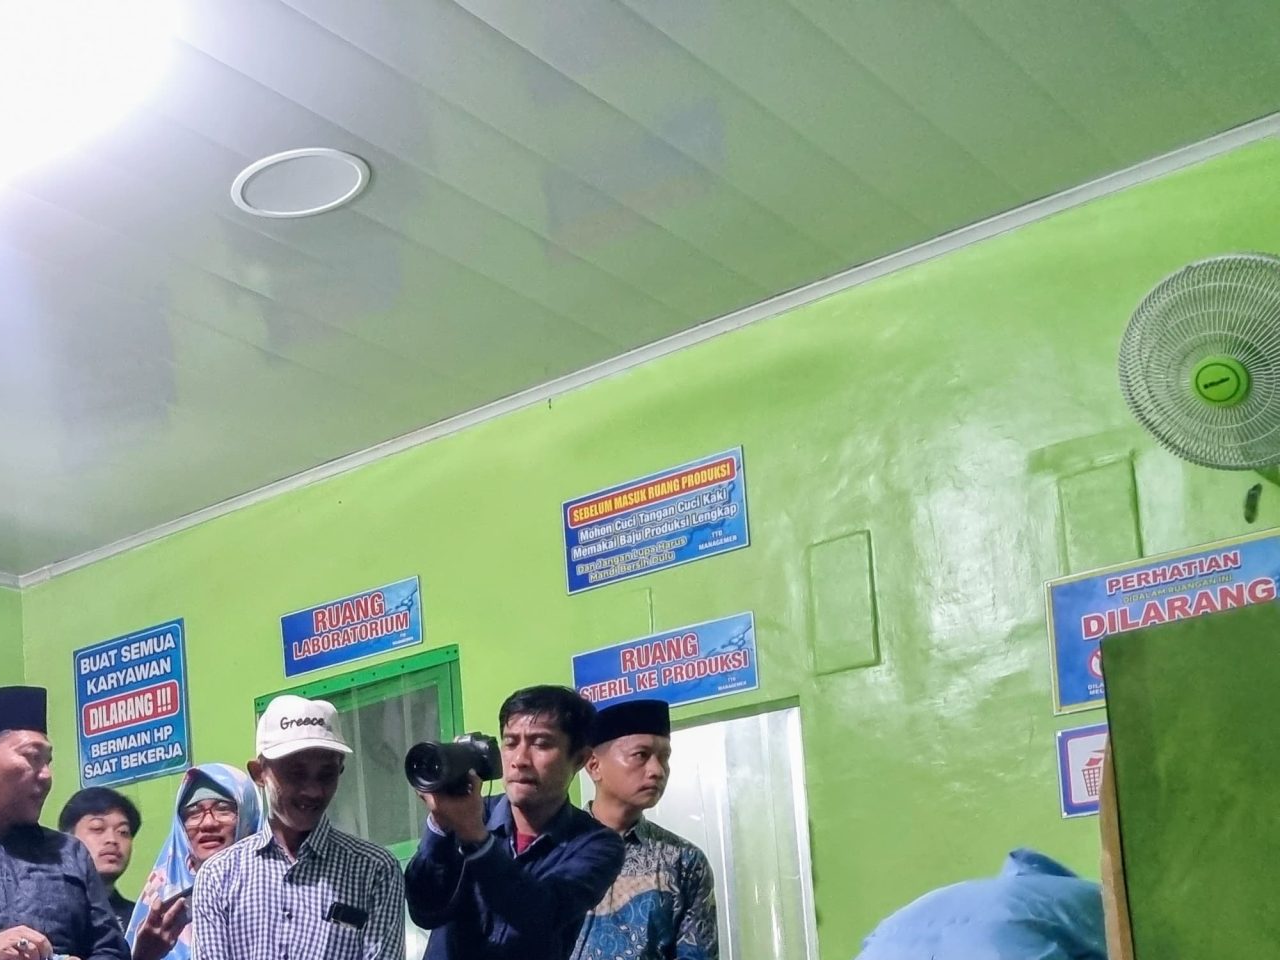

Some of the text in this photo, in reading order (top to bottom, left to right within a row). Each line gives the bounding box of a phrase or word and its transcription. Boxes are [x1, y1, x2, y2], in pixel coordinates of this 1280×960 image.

[573, 462, 731, 522] SEBELUM MASUK RUANG PRODUKSI
[572, 503, 738, 561] Memakai Baju Produksi Lengkap
[579, 489, 728, 542] Mohon Cuci Tangan Cuci Kaki
[577, 537, 687, 575] Dan Jangan Lupa Harus
[589, 567, 618, 583] Mandi
[618, 559, 650, 574] Bersih
[1106, 550, 1241, 595] PERHATIAN
[313, 591, 385, 634] RUANG
[1081, 577, 1277, 641] DILARANG
[80, 633, 175, 674] BUAT SEMUA
[293, 611, 410, 660] LABORATORIUM
[620, 633, 698, 673] RUANG
[87, 657, 171, 695] KARYAWAN
[579, 649, 749, 703] STERIL KE PRODUKSI
[90, 687, 171, 731] DILARANG !!!
[280, 717, 325, 730] Greece
[84, 742, 183, 779] SAAT BEKERJA
[91, 725, 173, 757] BERMAIN HP
